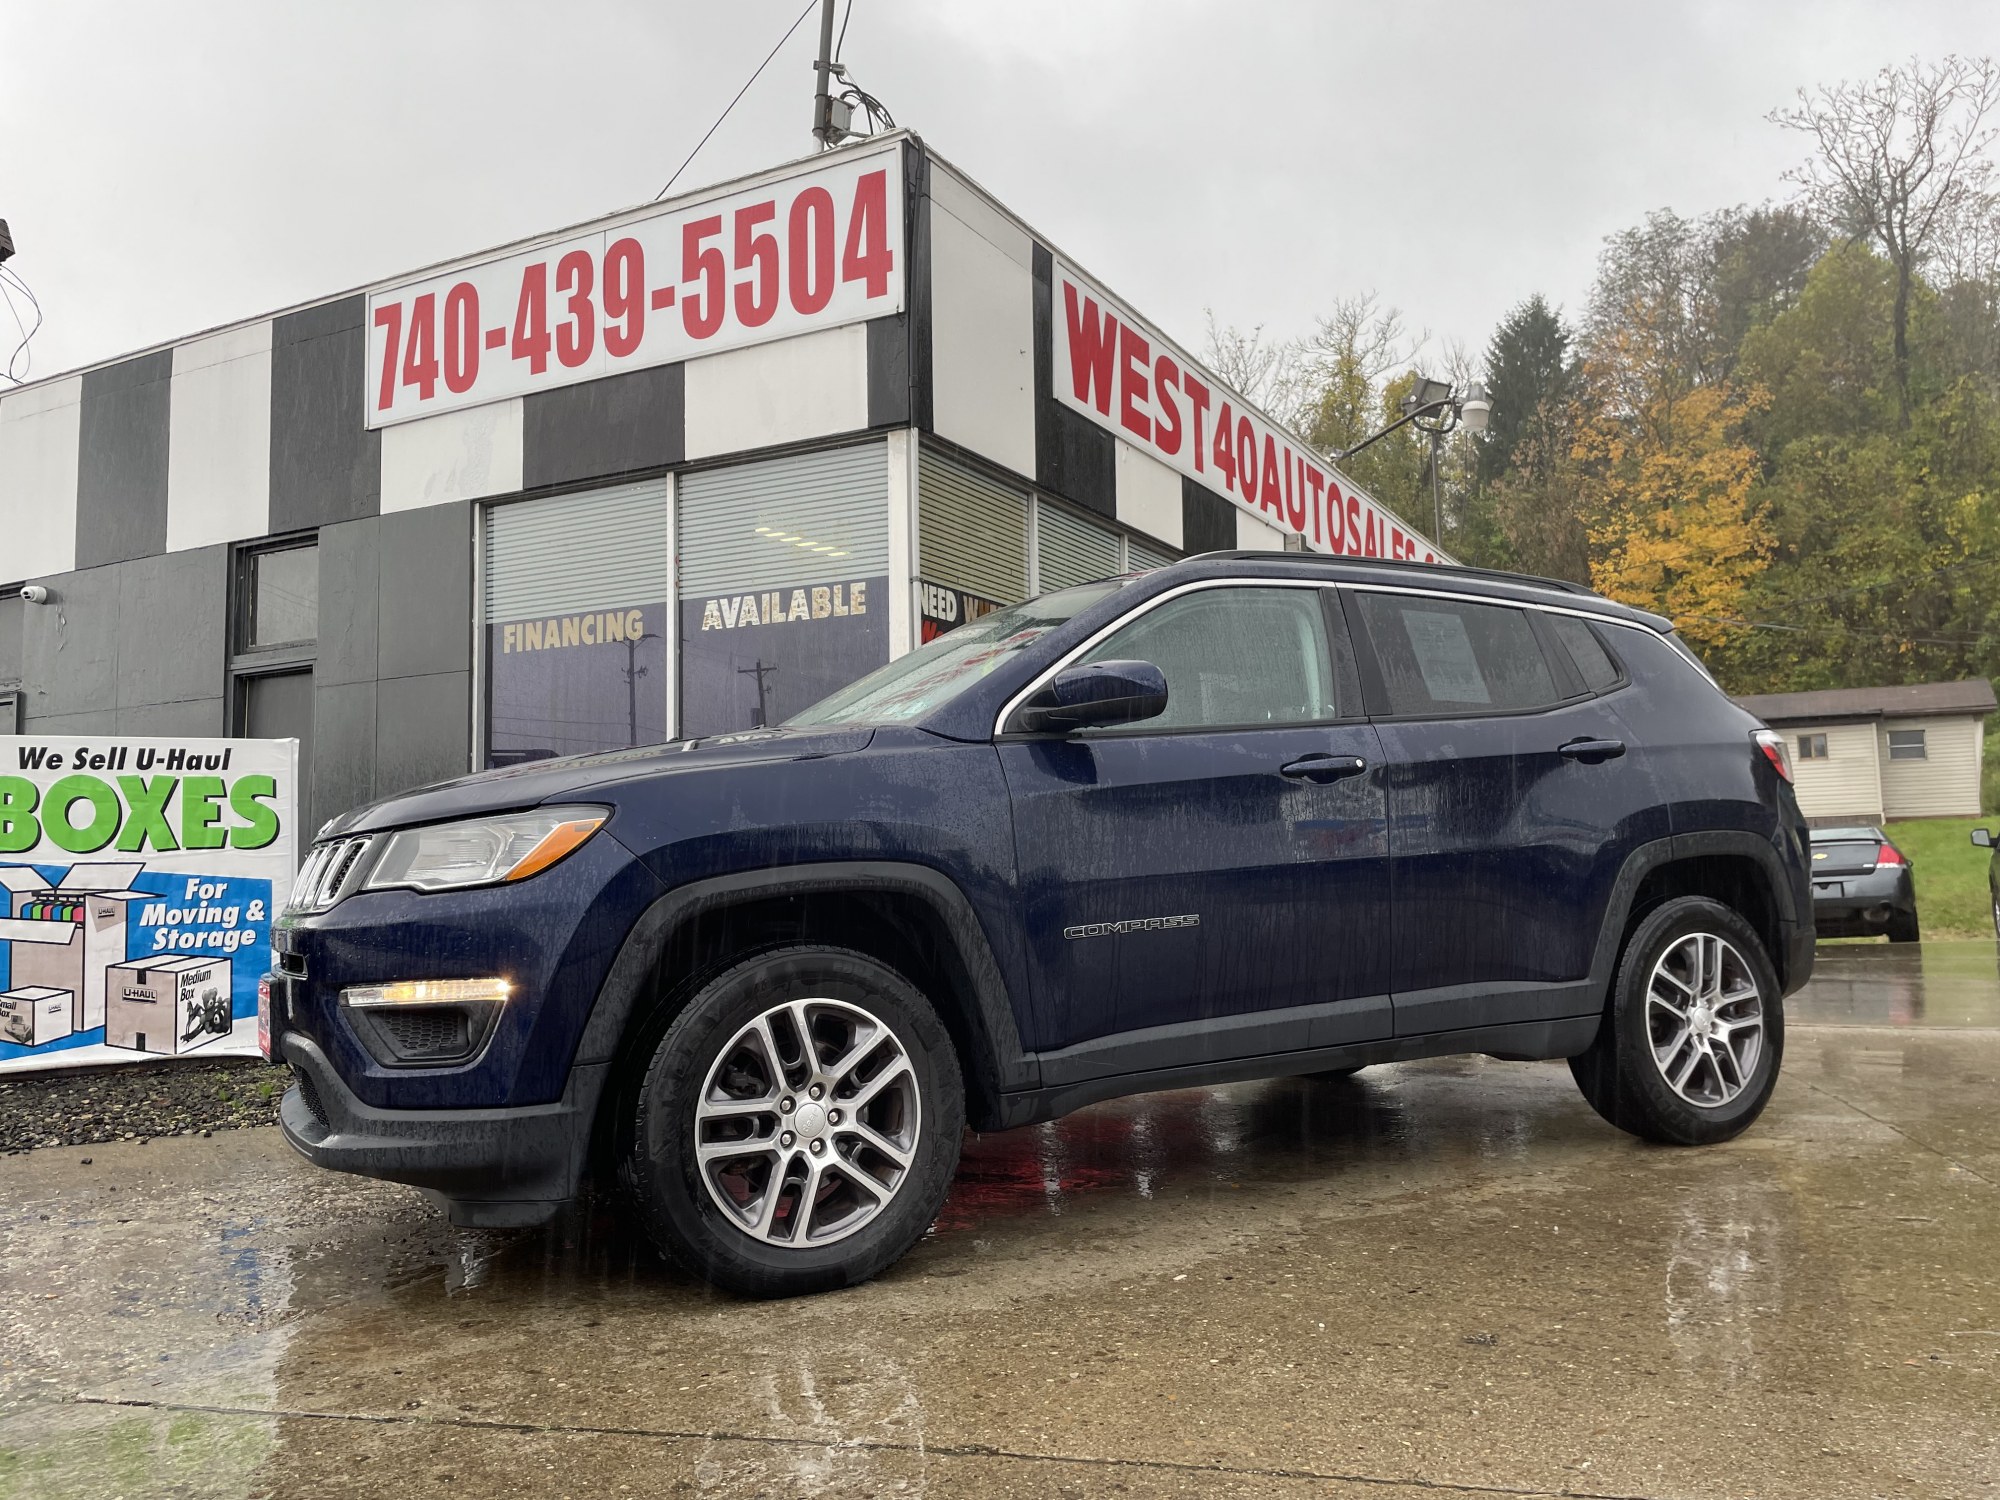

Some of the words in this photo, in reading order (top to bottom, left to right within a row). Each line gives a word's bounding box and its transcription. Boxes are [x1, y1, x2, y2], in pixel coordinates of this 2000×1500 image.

[375, 168, 894, 411] 740-439-5504
[920, 581, 958, 623] NEED
[503, 609, 644, 655] FINANCING
[701, 581, 867, 632] AVAILABLE
[18, 747, 63, 770] We
[72, 747, 127, 770] Sell
[136, 747, 231, 771] U-Haul
[0, 774, 281, 854] BOXES
[184, 878, 228, 901] For
[139, 901, 242, 929] Moving
[246, 900, 266, 923] &
[1064, 914, 1200, 940] COMPASS
[152, 927, 257, 952] Storage
[180, 970, 212, 988] Medium
[0, 1001, 17, 1011] mall
[123, 988, 156, 1000] U-HAUL
[180, 987, 195, 1002] Box
